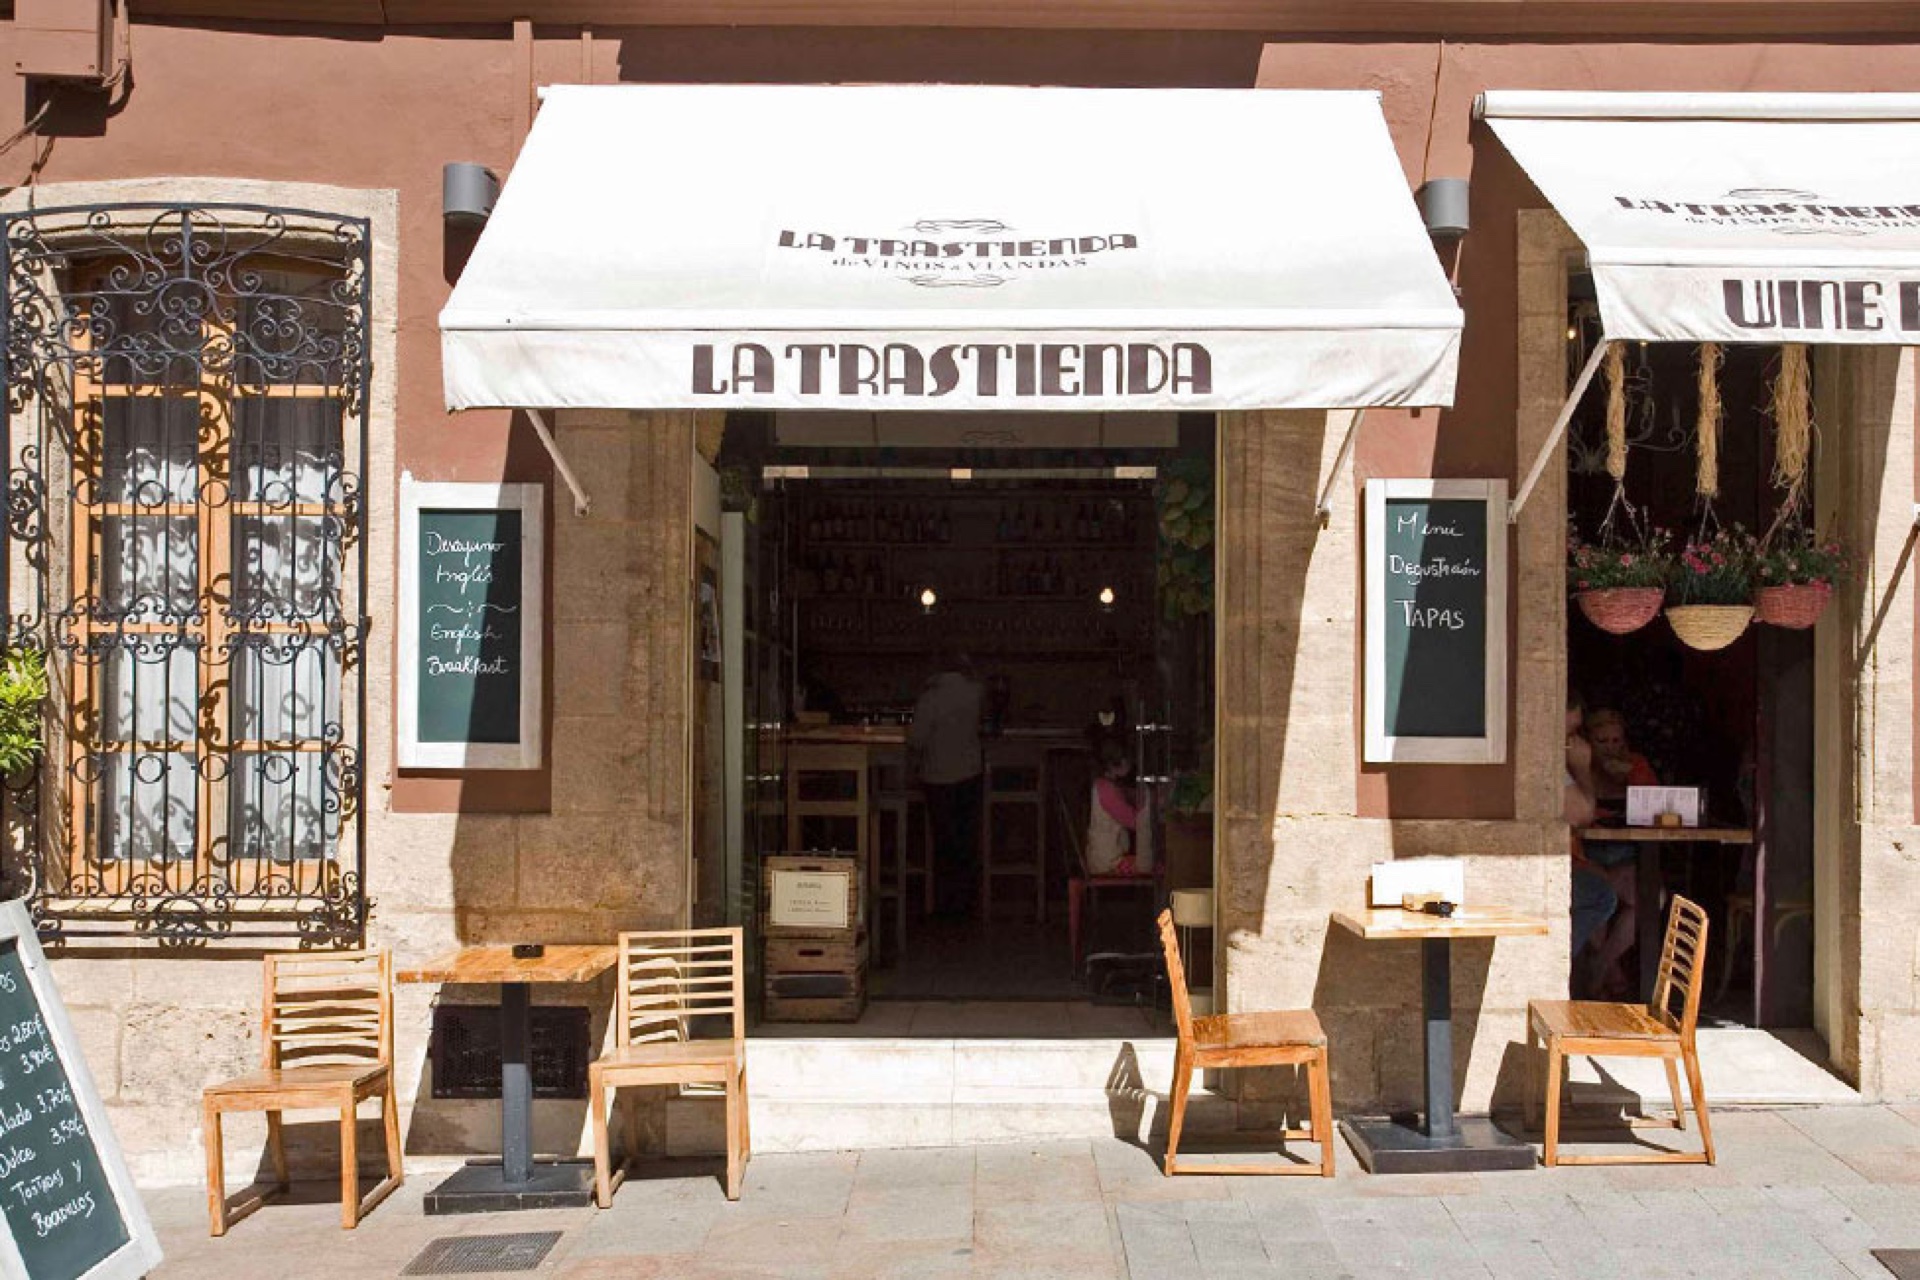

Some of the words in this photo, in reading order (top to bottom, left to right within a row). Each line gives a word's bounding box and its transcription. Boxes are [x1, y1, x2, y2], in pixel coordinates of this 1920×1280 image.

[778, 230, 835, 252] LA
[843, 233, 1139, 258] TRASTIENDA
[1722, 279, 1884, 331] WINE
[692, 342, 775, 395] LA
[785, 342, 1213, 397] TRASTIENDA
[1393, 600, 1465, 630] TAPAS
[430, 622, 503, 655] English
[426, 655, 510, 676] Breakfast
